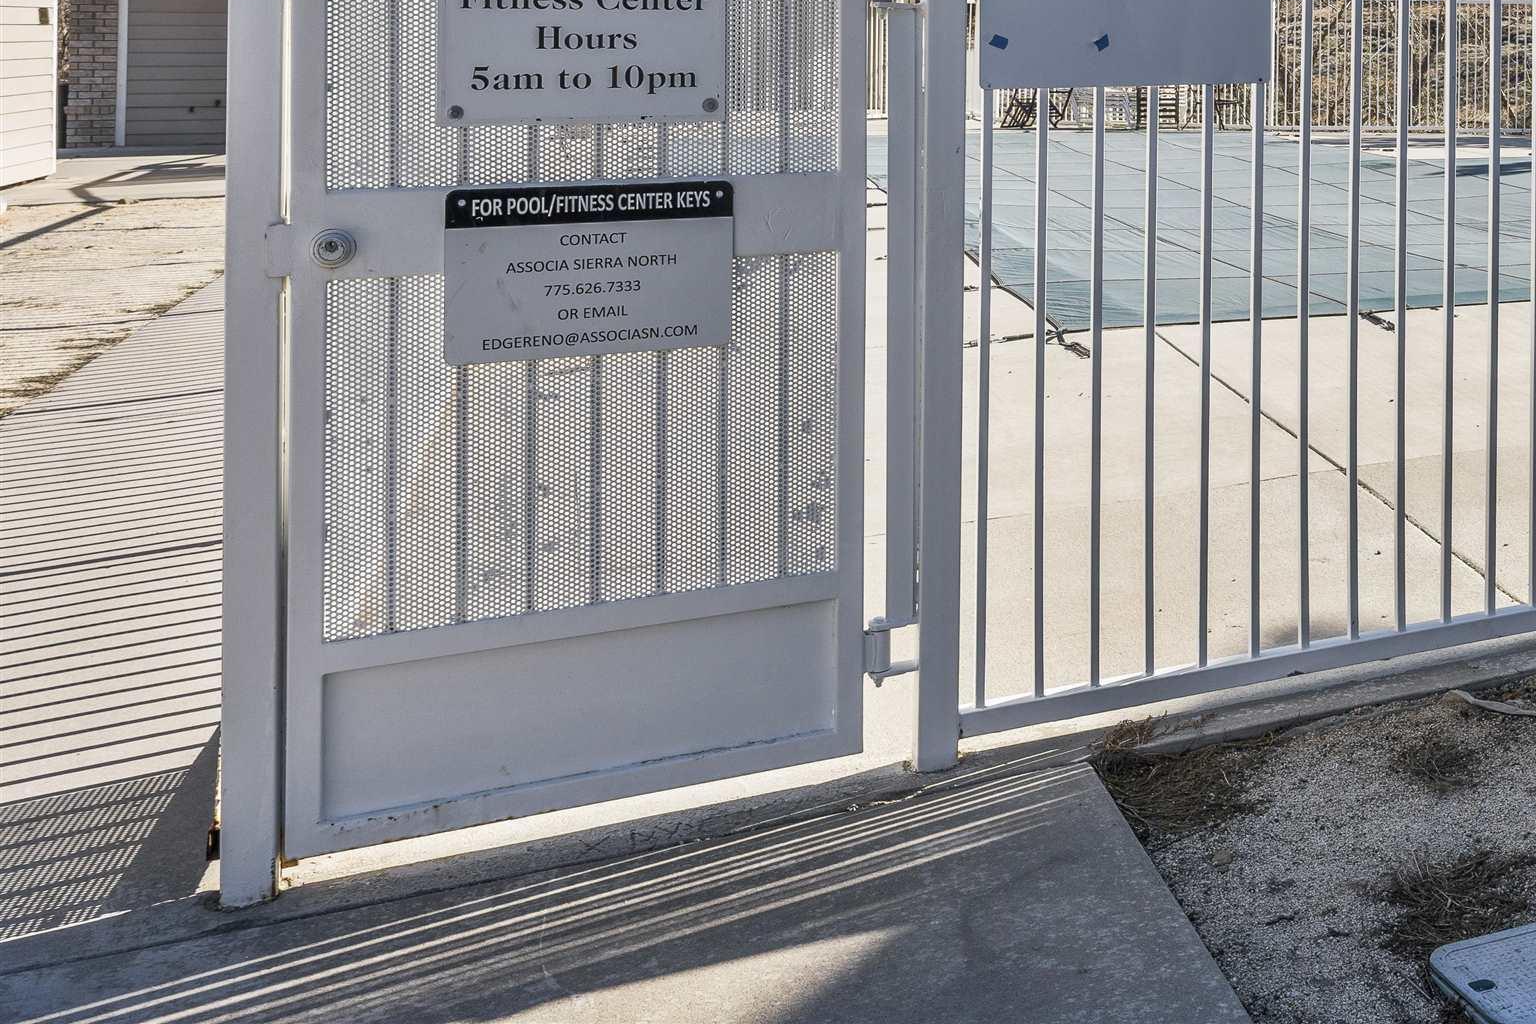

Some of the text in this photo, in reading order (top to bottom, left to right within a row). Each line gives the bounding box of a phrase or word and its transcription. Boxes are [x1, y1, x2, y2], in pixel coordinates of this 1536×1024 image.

[536, 26, 638, 50] Hours
[471, 65, 697, 94] 5am to 10pm
[471, 190, 711, 218] FOR POOL/FITNESS CENTER KEYS
[559, 232, 628, 247] CONTACT
[506, 253, 678, 274] ASSOCIA SIERRA NORTH
[544, 280, 642, 297] 775.626.7333
[557, 306, 628, 322] OR EMAIL
[482, 324, 698, 351] EDGERENO@ASSOCIASN.COM
